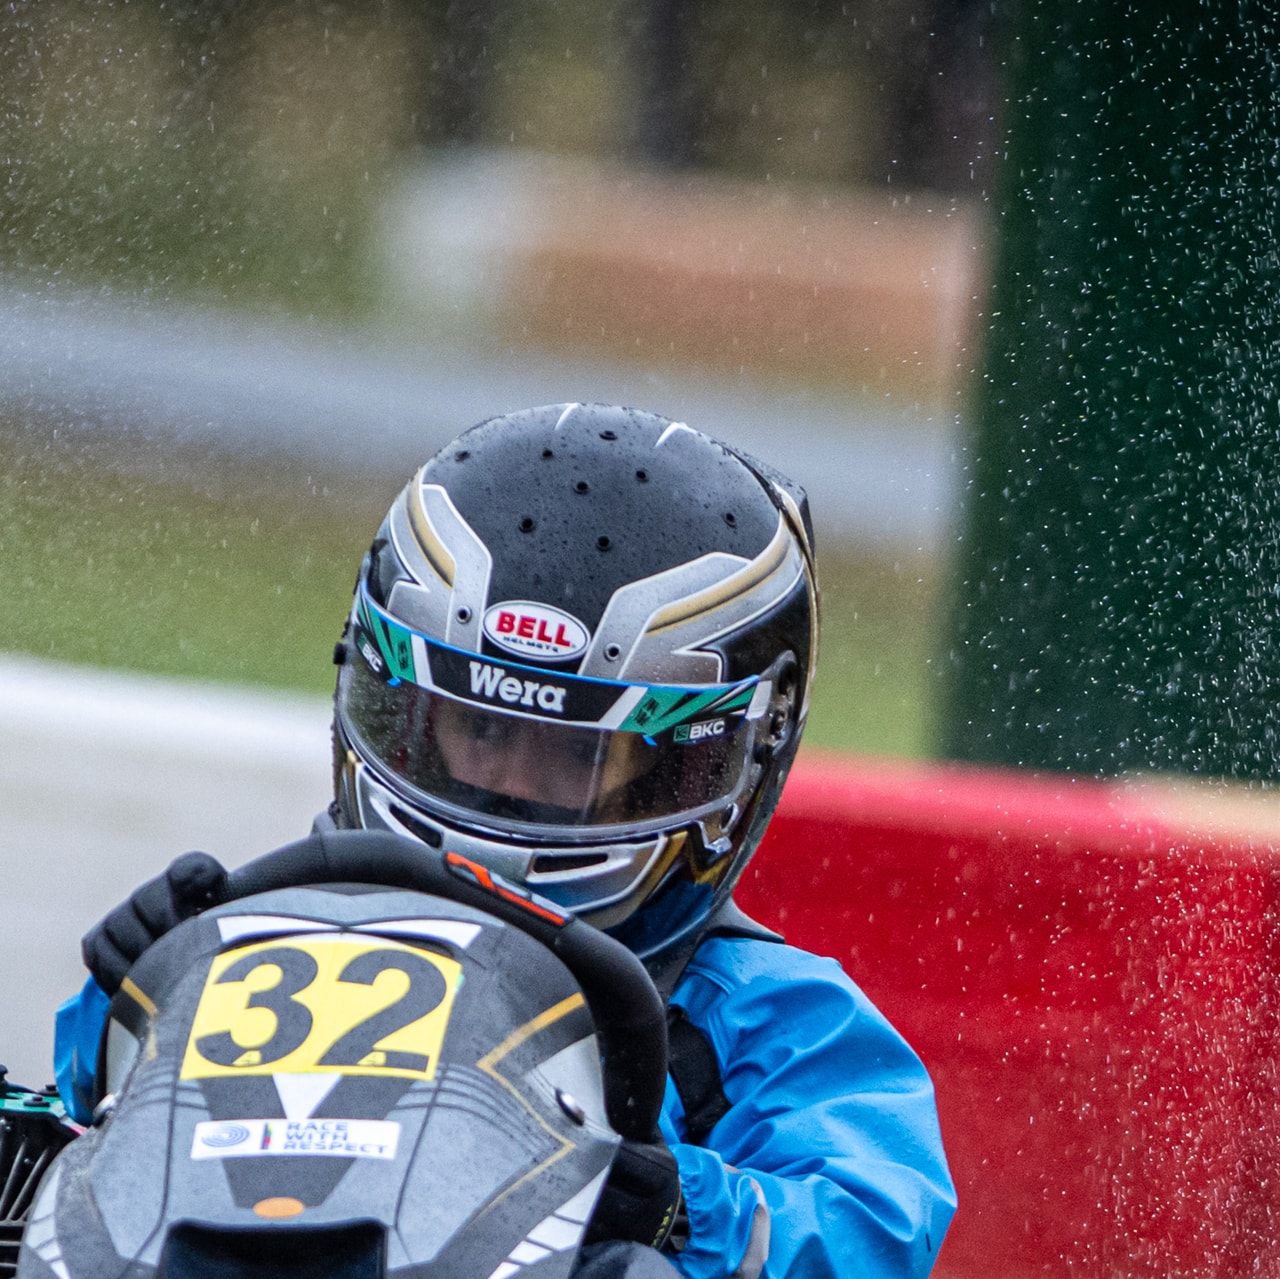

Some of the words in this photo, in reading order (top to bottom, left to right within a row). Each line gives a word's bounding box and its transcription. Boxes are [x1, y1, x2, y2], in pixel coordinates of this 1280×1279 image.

[495, 610, 571, 648] BELL
[469, 661, 567, 713] Wera
[689, 721, 726, 740] BKC
[194, 946, 447, 1073] 32
[287, 1121, 348, 1131] RACE
[286, 1131, 348, 1141] WITH
[283, 1141, 389, 1154] RESPECT
